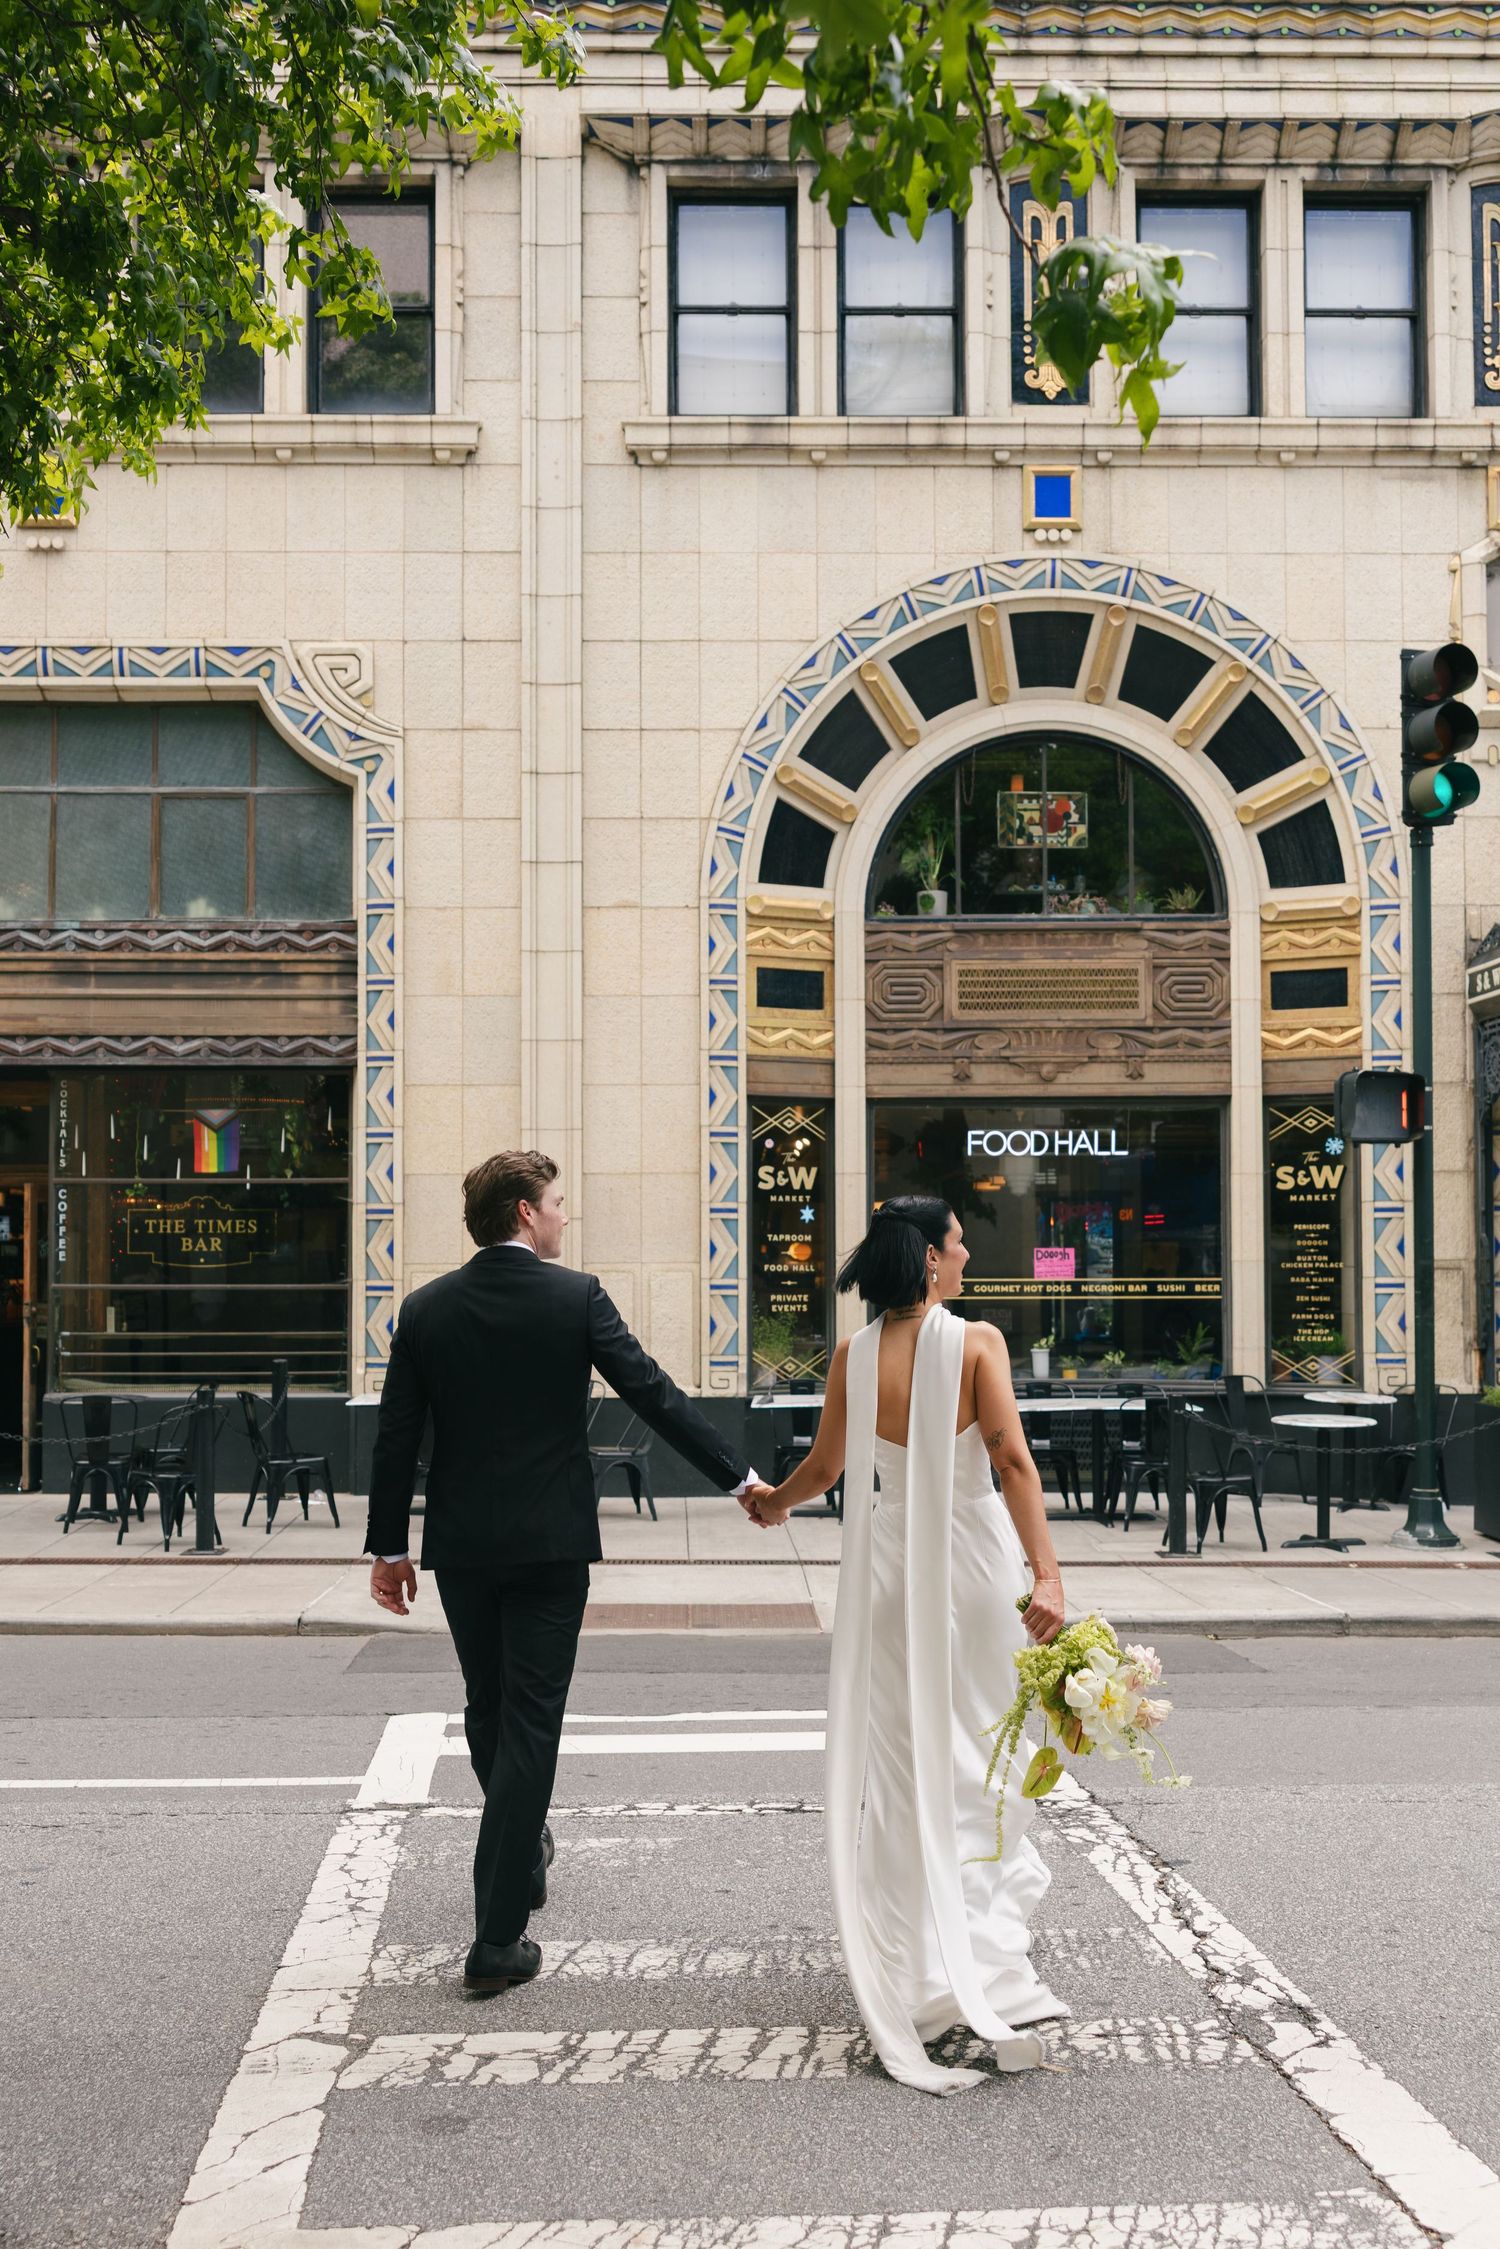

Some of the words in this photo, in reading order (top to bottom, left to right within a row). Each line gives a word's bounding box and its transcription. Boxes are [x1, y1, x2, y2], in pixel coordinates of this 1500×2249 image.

[59, 1079, 68, 1168] COCKTAILS
[968, 1130, 1049, 1156] FOOD
[1055, 1130, 1129, 1156] HALL
[781, 1152, 797, 1165] The
[1302, 1151, 1320, 1164] The
[757, 1165, 818, 1190] S&W
[1276, 1165, 1344, 1190] S&W
[769, 1194, 811, 1202] MARKET
[1290, 1194, 1336, 1202] MARKET
[58, 1189, 68, 1261] COFFEE
[145, 1219, 186, 1233] THE
[195, 1219, 257, 1233] TIMES
[1293, 1223, 1330, 1231] PERISCOPE
[767, 1233, 812, 1242] TAPROOM
[181, 1238, 223, 1252] BAR
[1296, 1254, 1329, 1262] BUXTON
[763, 1264, 790, 1272] FOOD
[791, 1264, 815, 1272] HALL
[1314, 1261, 1344, 1269] PALACE
[974, 1284, 1021, 1293] GOURMET
[1024, 1284, 1044, 1293] HOT
[1046, 1284, 1073, 1293] DOGS
[1081, 1284, 1125, 1293] NEGRONI
[1128, 1284, 1148, 1293] BAR
[1156, 1284, 1186, 1293] SUSHI
[1194, 1284, 1221, 1292] BEER
[770, 1294, 809, 1302] PRIVATE
[771, 1304, 808, 1312] EVENTS
